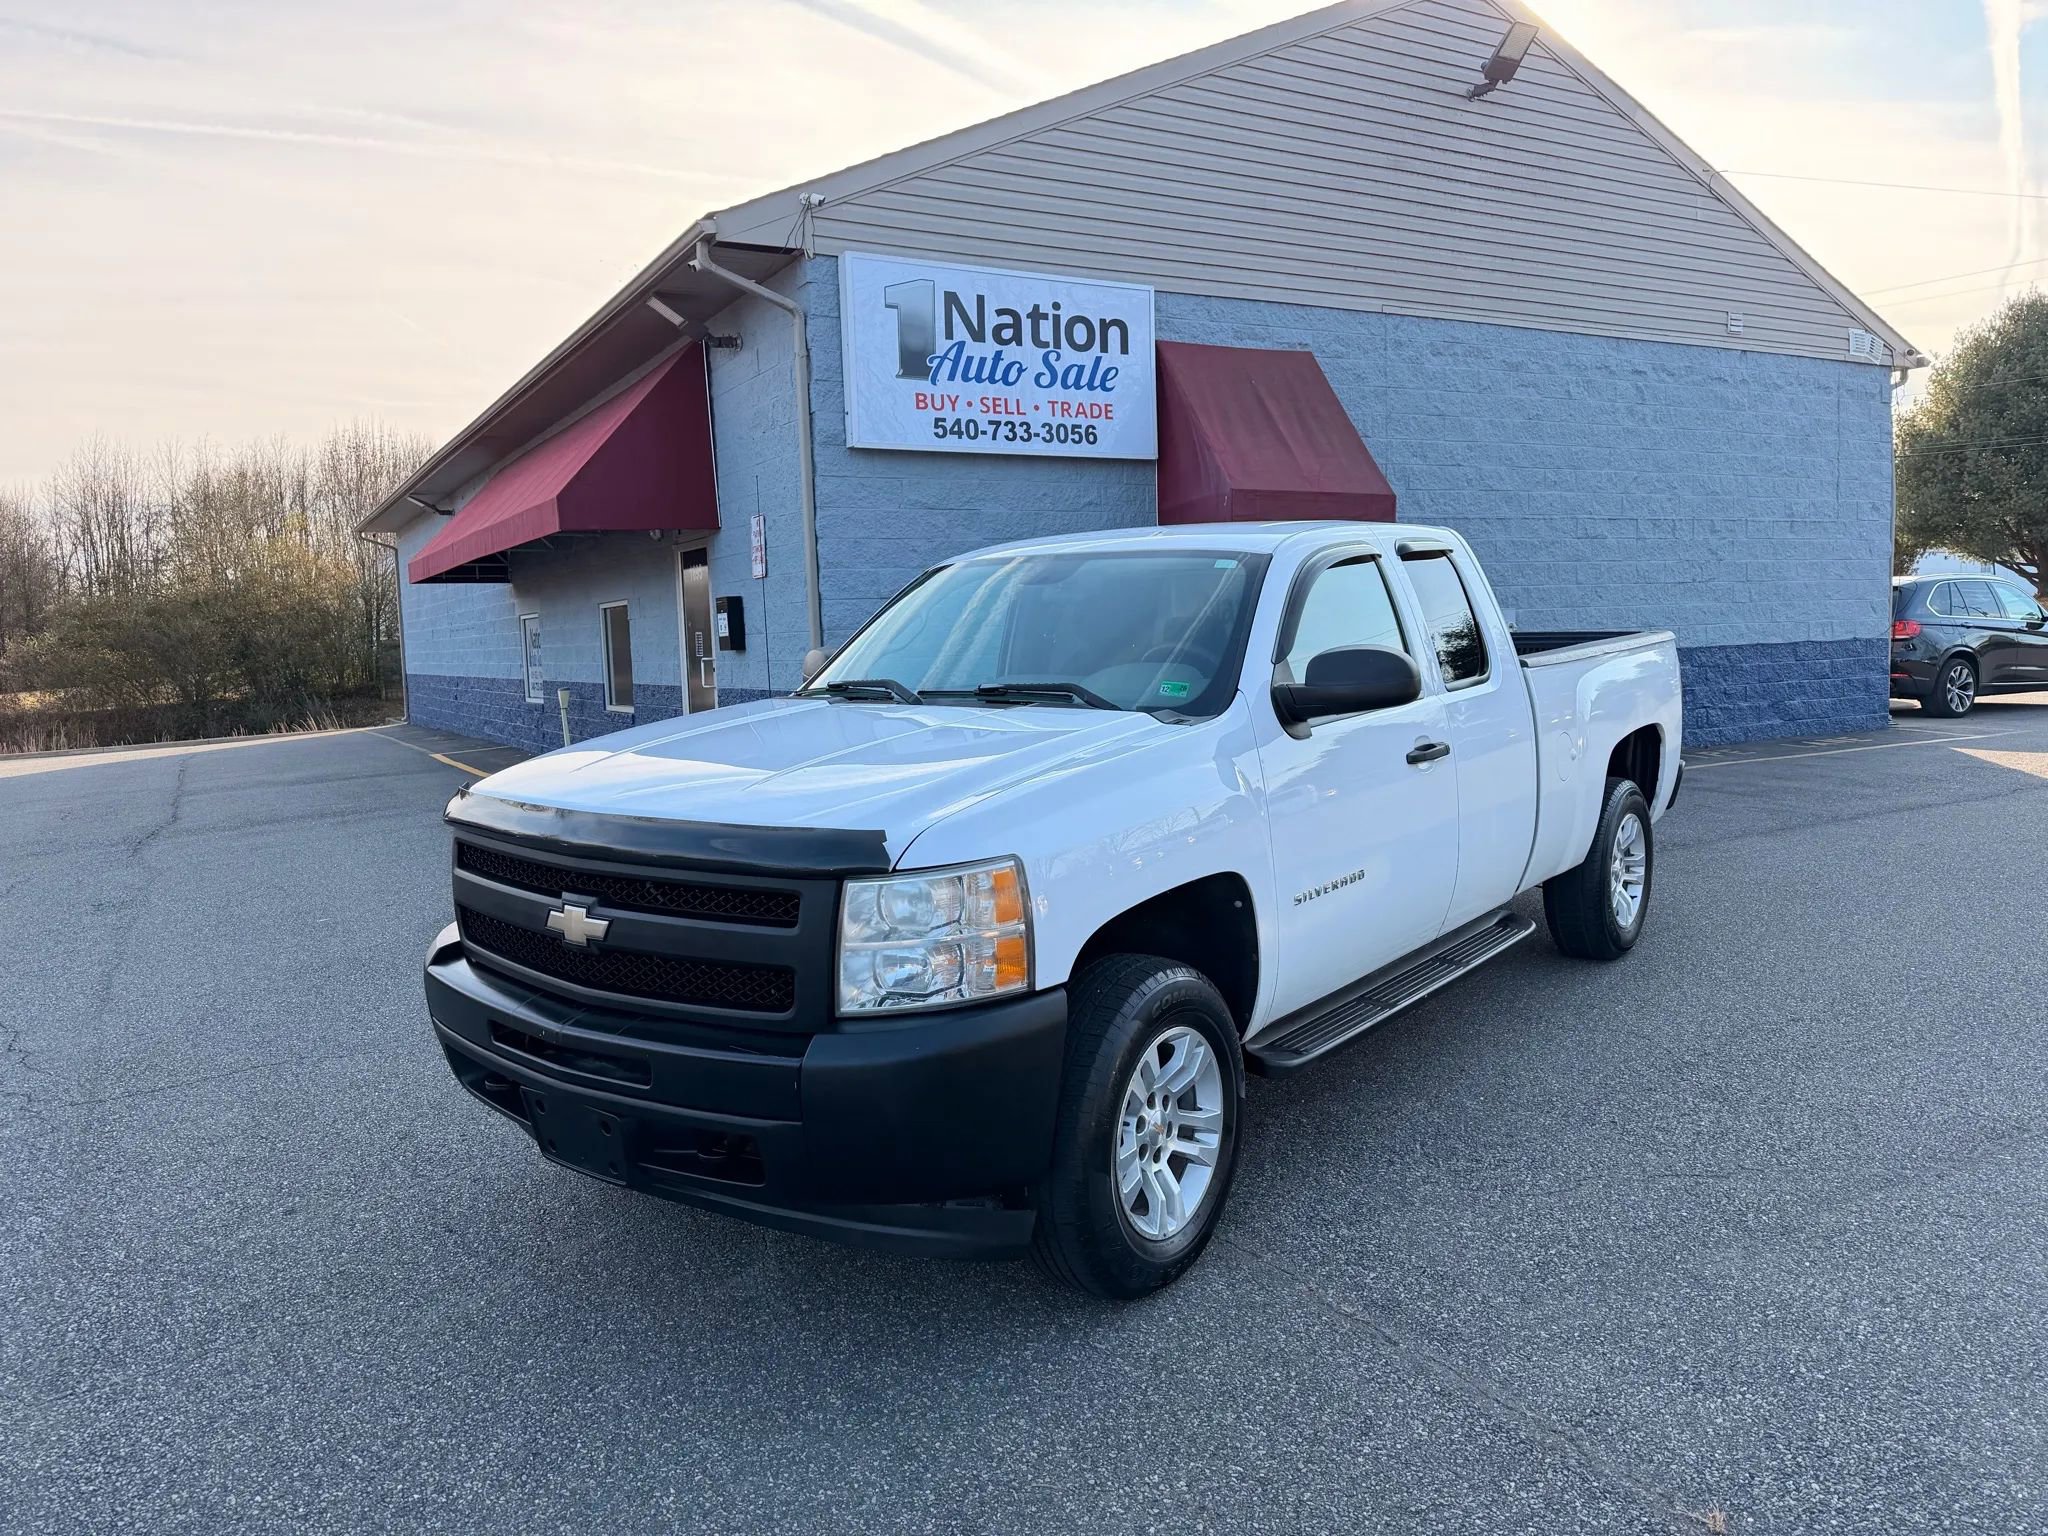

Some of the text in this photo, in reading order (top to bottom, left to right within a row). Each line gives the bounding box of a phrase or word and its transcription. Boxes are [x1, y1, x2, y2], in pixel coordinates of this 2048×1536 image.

[884, 278, 1129, 381] 1 Nation
[927, 340, 1119, 392] Auto Sale
[914, 392, 1114, 420] BUY SELL TRADE
[933, 417, 1098, 445] 540-733-3056
[1293, 869, 1366, 906] SILVERADO
